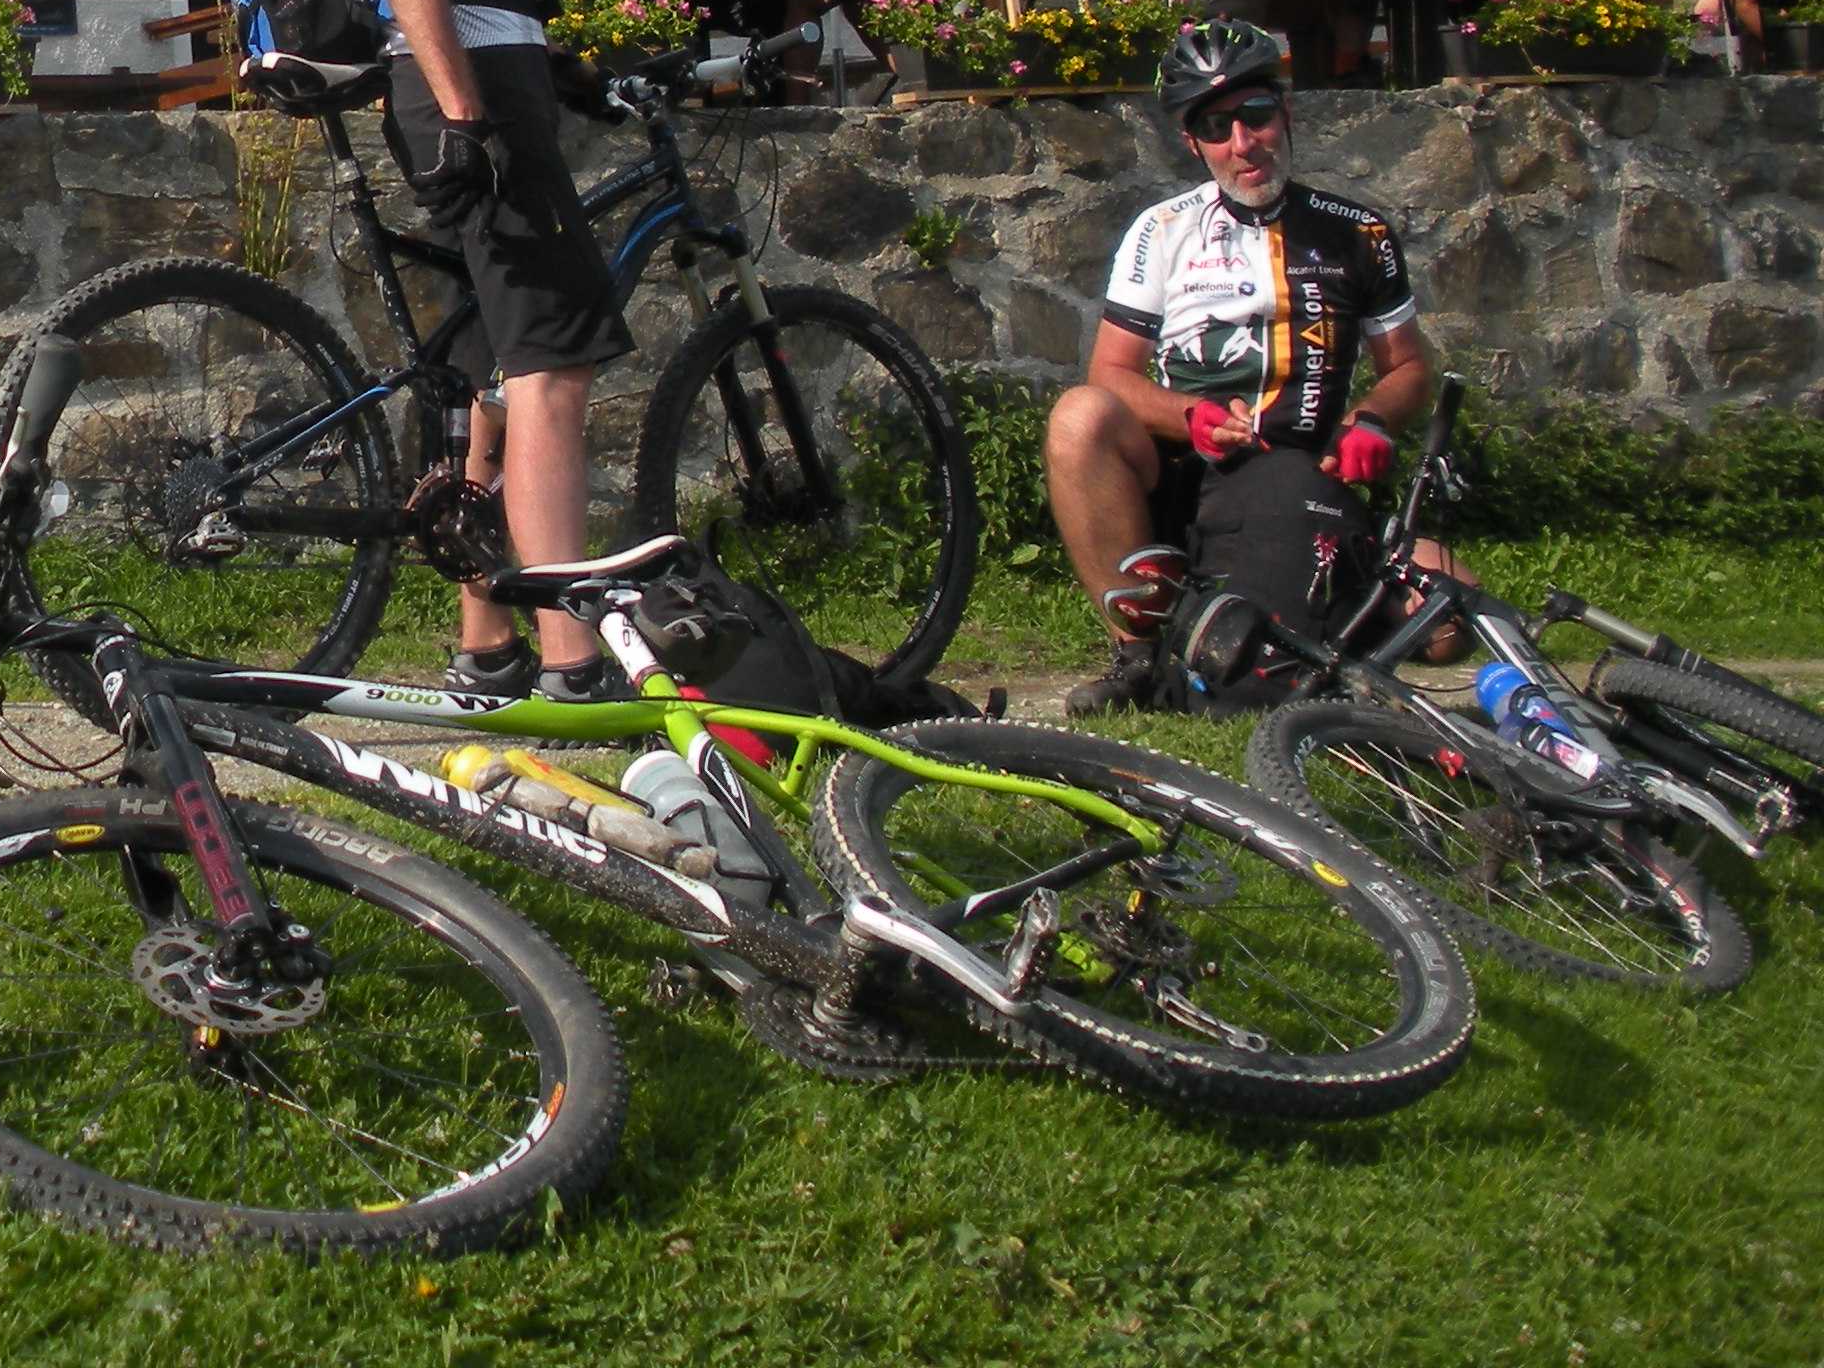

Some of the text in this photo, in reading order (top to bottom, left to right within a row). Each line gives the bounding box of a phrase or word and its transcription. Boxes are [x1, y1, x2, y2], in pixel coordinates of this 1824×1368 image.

[1128, 215, 1159, 285] brenner
[1170, 193, 1205, 214] com
[1309, 193, 1378, 224] brenner
[1379, 238, 1398, 278] com
[1184, 283, 1234, 294] Telefonia
[1188, 256, 1246, 270] NERA
[1292, 282, 1325, 432] brenner com
[366, 687, 443, 706] 9000
